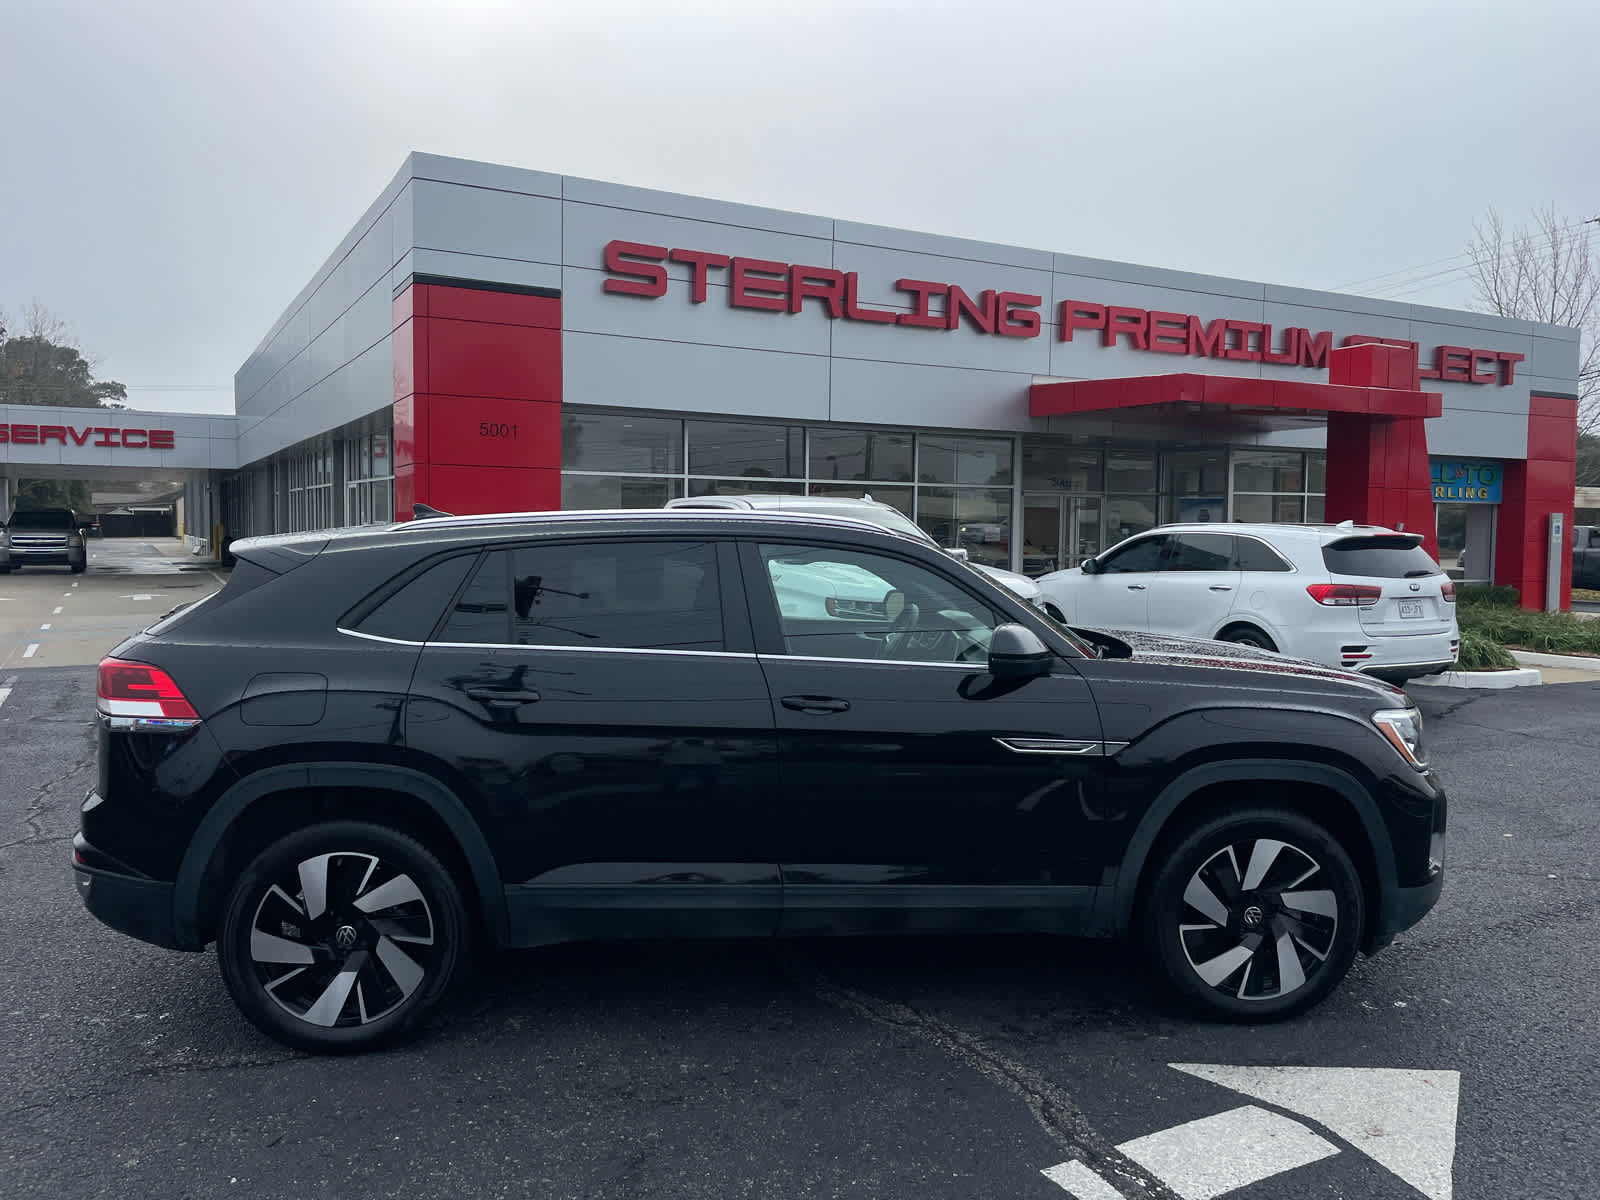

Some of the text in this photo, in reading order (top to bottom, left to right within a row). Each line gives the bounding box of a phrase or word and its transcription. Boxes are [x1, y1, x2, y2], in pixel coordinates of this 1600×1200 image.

[604, 239, 1042, 338] STERLING
[1059, 299, 1333, 369] PREMIUM
[479, 422, 518, 441] 5001
[1464, 465, 1497, 484] TO
